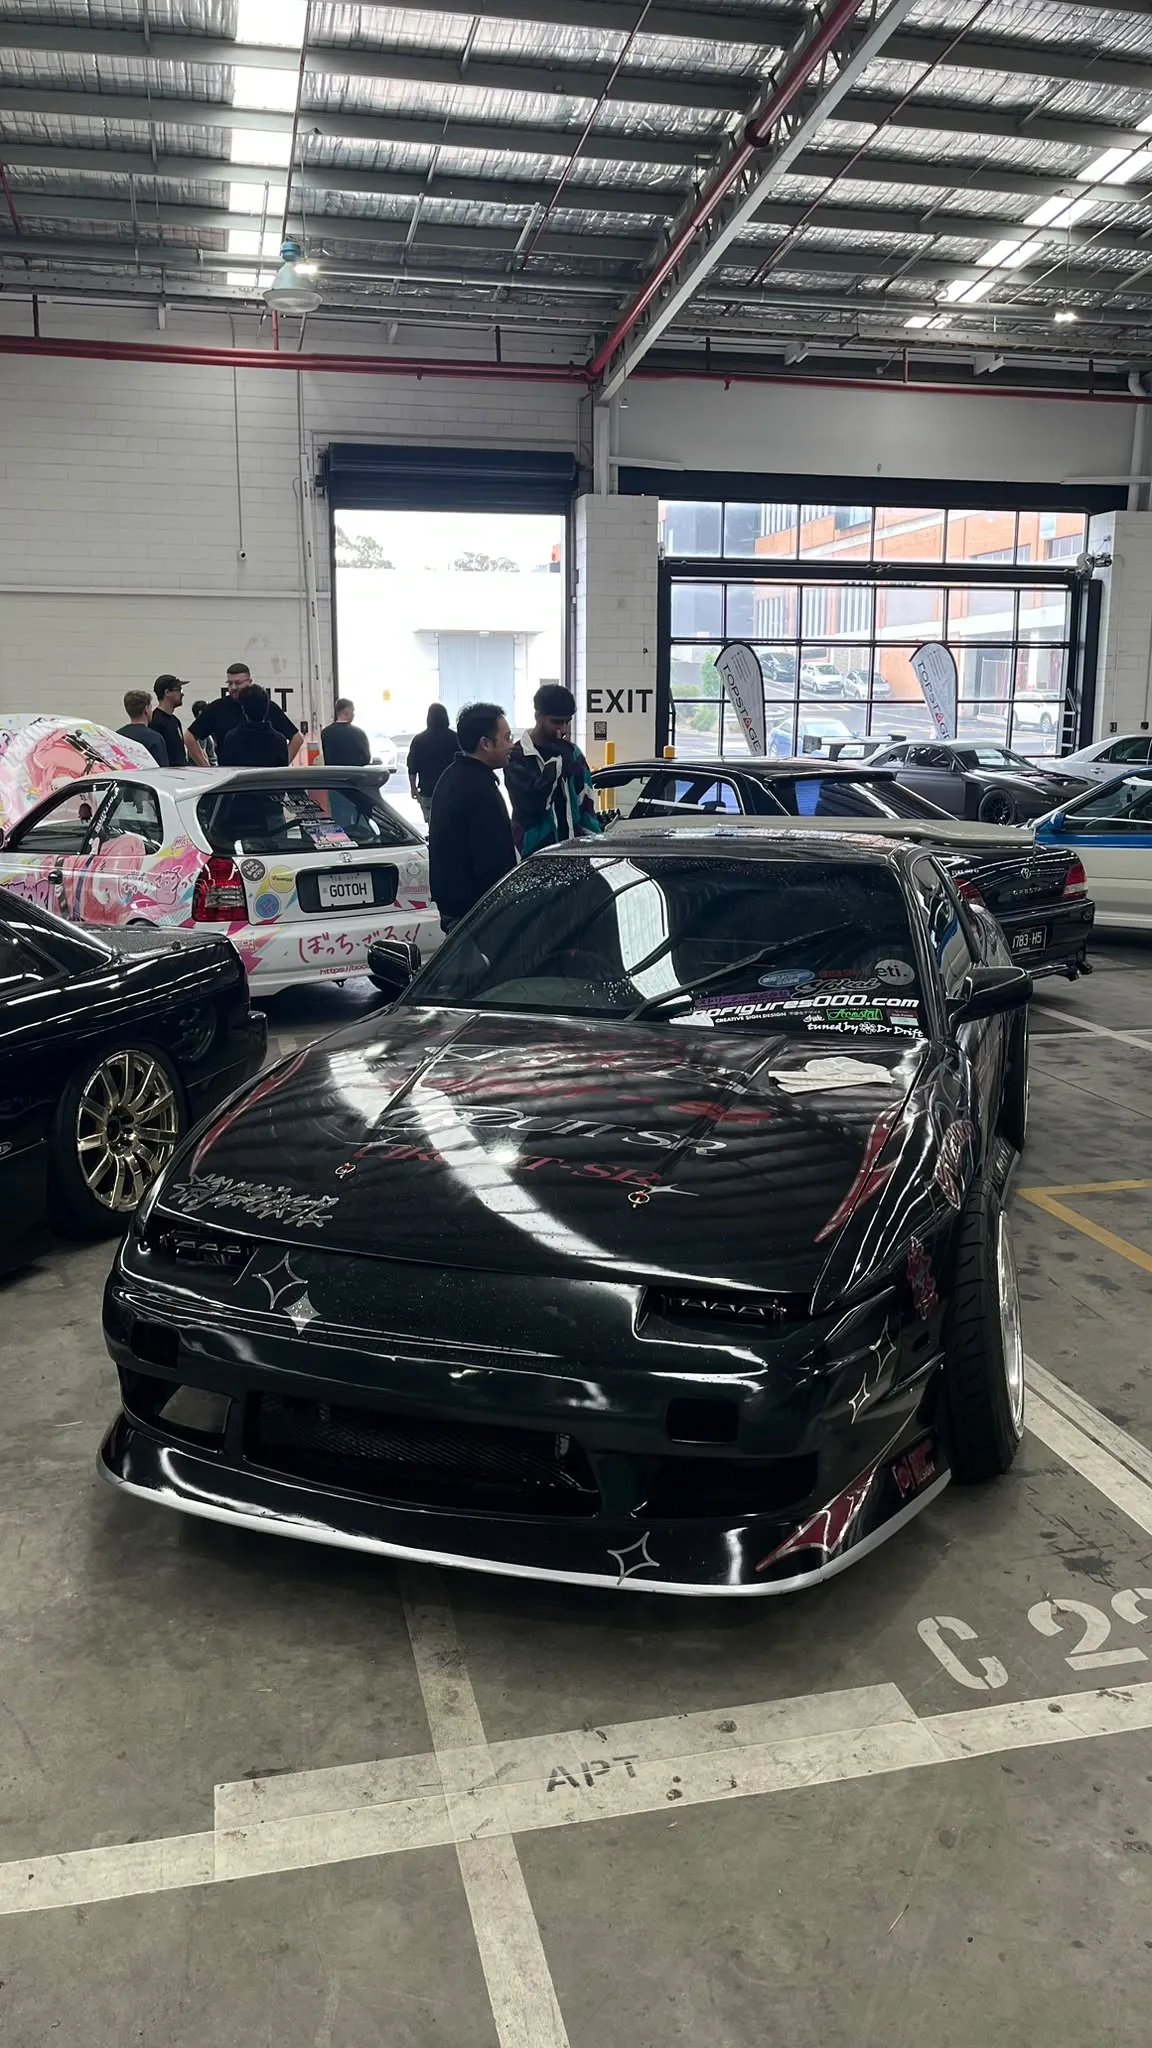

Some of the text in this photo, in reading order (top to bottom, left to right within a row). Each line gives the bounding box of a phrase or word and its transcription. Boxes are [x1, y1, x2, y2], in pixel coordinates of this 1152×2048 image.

[587, 689, 653, 713] EXIT
[723, 664, 761, 752] TOPSTAGE
[330, 883, 367, 897] GOTOH
[715, 1015, 744, 1024] CREATIVE
[807, 1021, 924, 1039] tuned by Dr Drift
[916, 1615, 1009, 1690] C
[546, 1754, 640, 1793] APT
